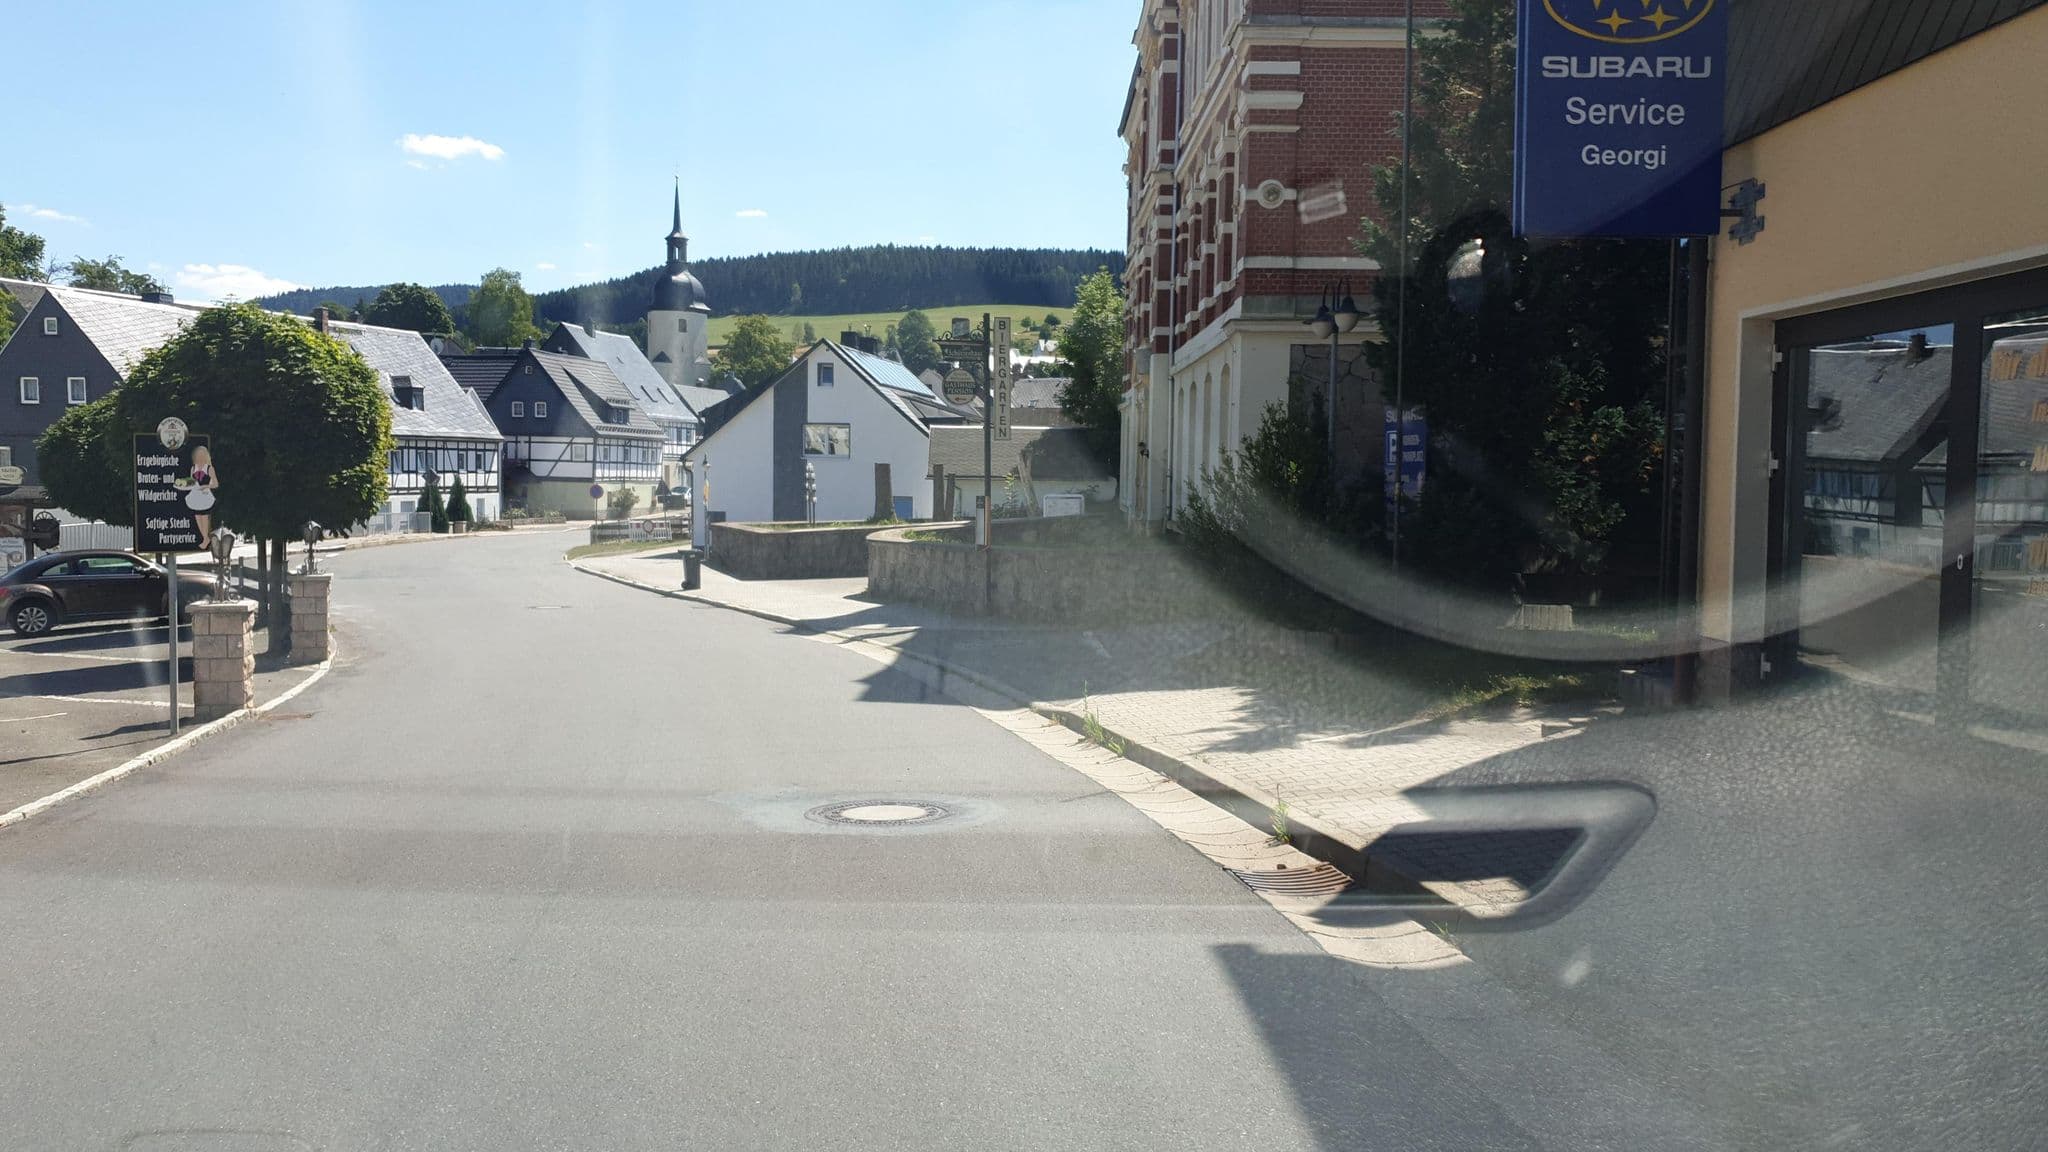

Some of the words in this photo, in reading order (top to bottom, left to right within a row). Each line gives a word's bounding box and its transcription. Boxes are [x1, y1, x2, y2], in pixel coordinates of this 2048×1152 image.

[1542, 56, 1712, 78] SUBARU
[1565, 96, 1686, 125] Service
[1581, 144, 1667, 170] Georgi
[998, 320, 1007, 438] BIERGARTEN
[1385, 408, 1424, 423] SUAR
[137, 454, 179, 467] Erzgebirgische
[137, 472, 162, 484] Braten-
[163, 472, 175, 484] und
[138, 489, 178, 502] Wildgerichte
[145, 517, 169, 530] Saftige
[169, 517, 191, 529] Steaks
[159, 532, 196, 544] Partyservice
